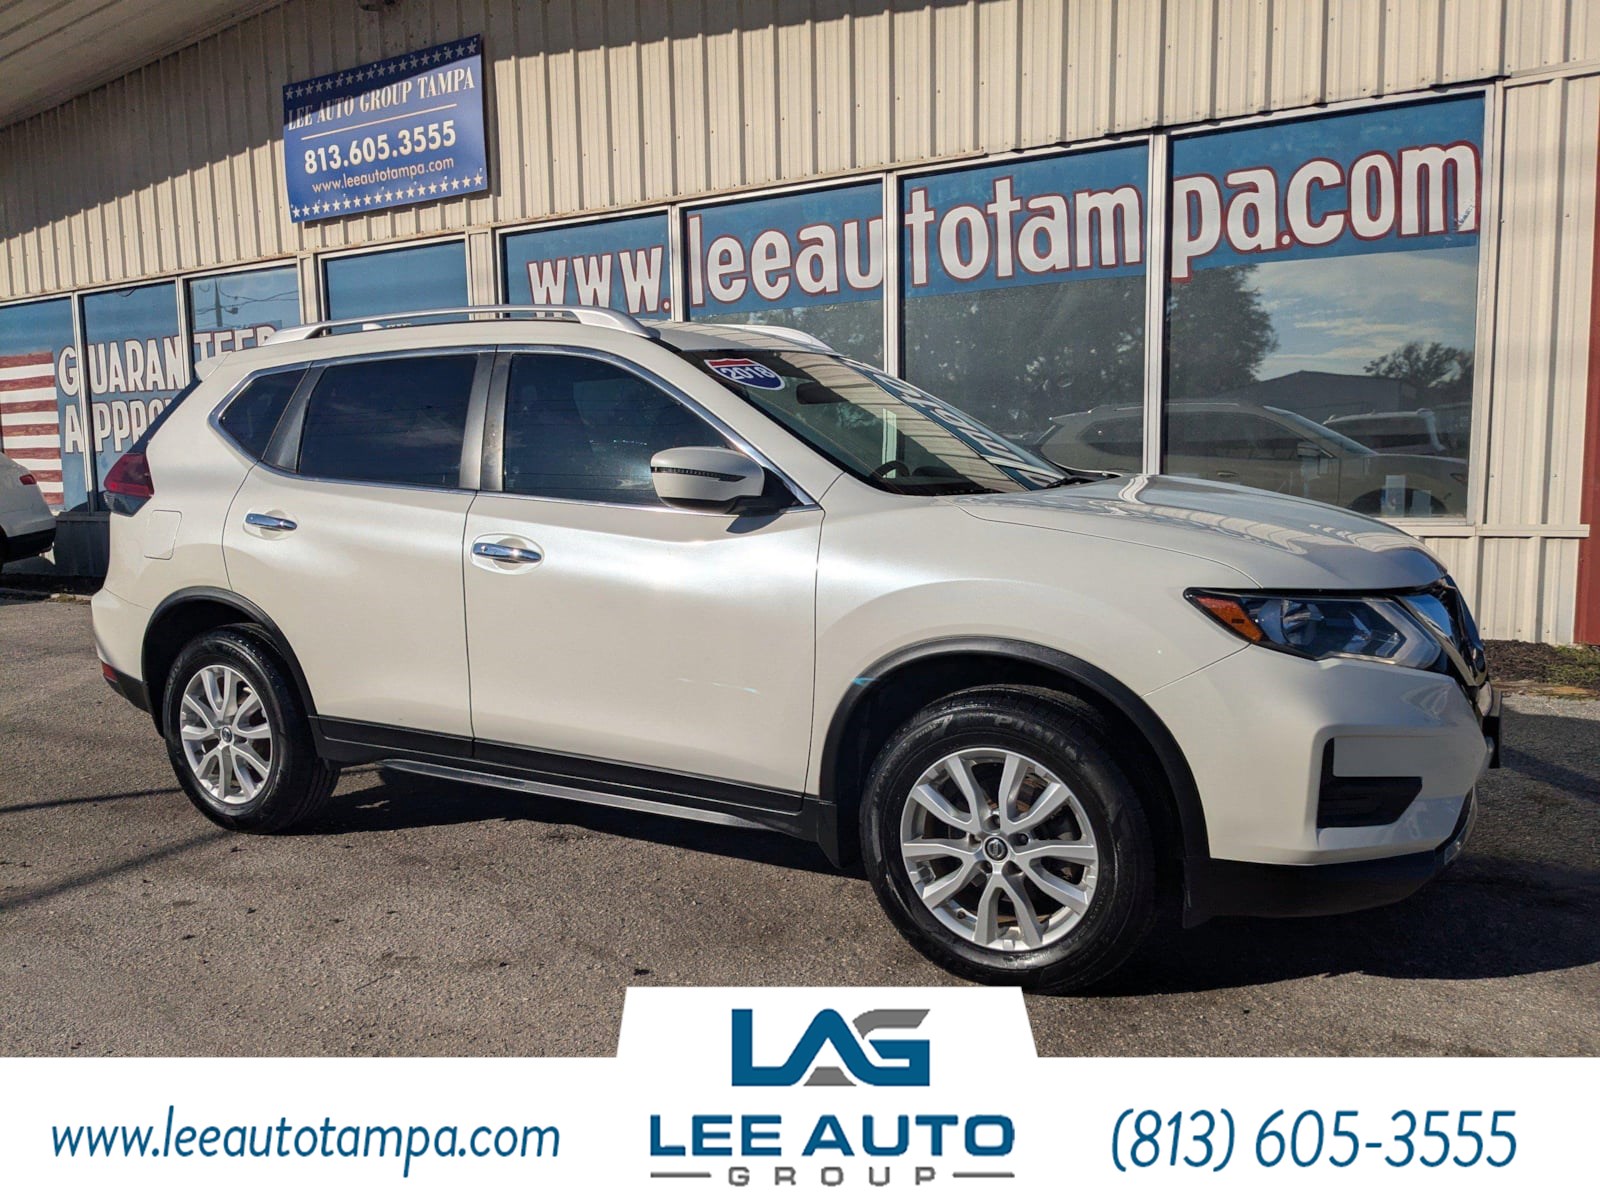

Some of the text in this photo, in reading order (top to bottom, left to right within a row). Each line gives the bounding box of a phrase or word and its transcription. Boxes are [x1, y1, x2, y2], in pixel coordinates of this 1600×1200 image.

[288, 66, 475, 130] LEE AUTO GROUP TAMPA
[304, 119, 456, 174] 813.605.3555
[312, 156, 454, 193] www.leeautotampa.com
[719, 366, 776, 380] 2018
[64, 398, 172, 453] APPR
